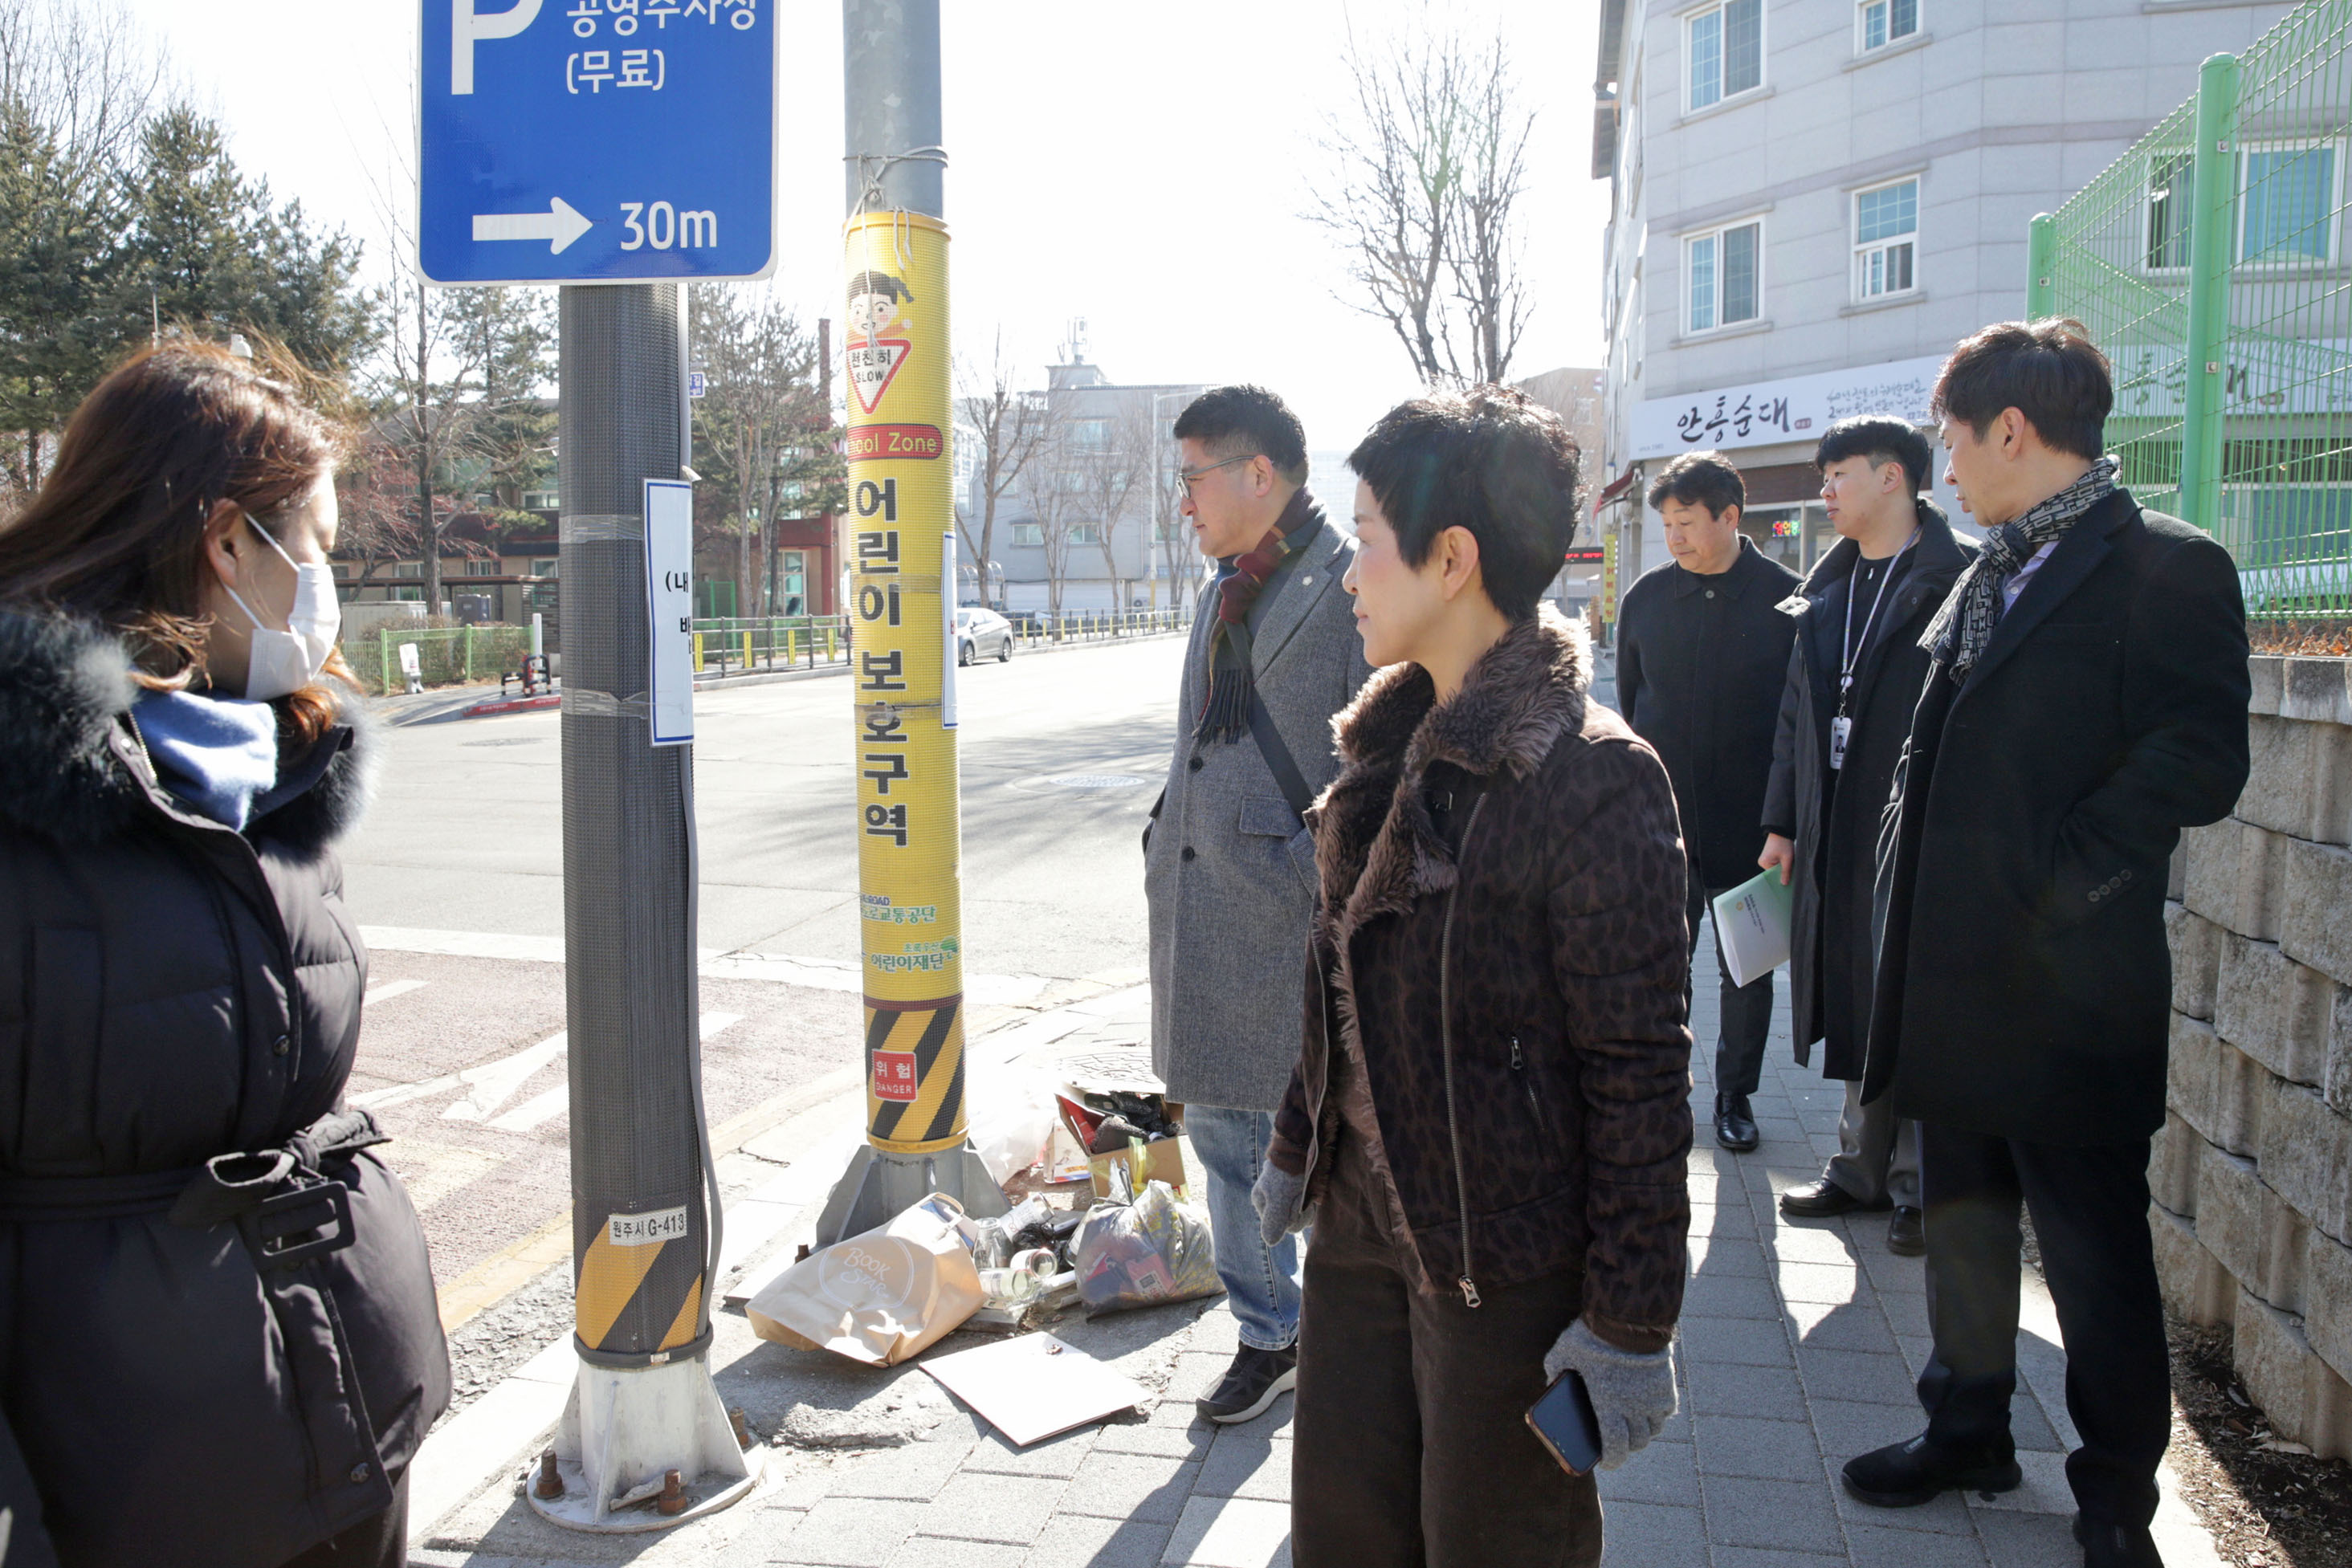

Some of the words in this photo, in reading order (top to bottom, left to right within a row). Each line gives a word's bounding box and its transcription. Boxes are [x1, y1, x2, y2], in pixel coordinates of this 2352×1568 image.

[566, 49, 665, 94] (무료)
[620, 200, 718, 251] 30m
[852, 348, 891, 368] 천천히
[855, 370, 884, 383] SLOW
[1677, 394, 1791, 443] 안흥순대
[887, 431, 939, 454] Zone
[871, 952, 944, 972] 어린이재단
[876, 1081, 912, 1094] DANGER
[613, 1220, 644, 1239] 원주시
[648, 1213, 684, 1236] G-413
[844, 1247, 891, 1281] BOOK
